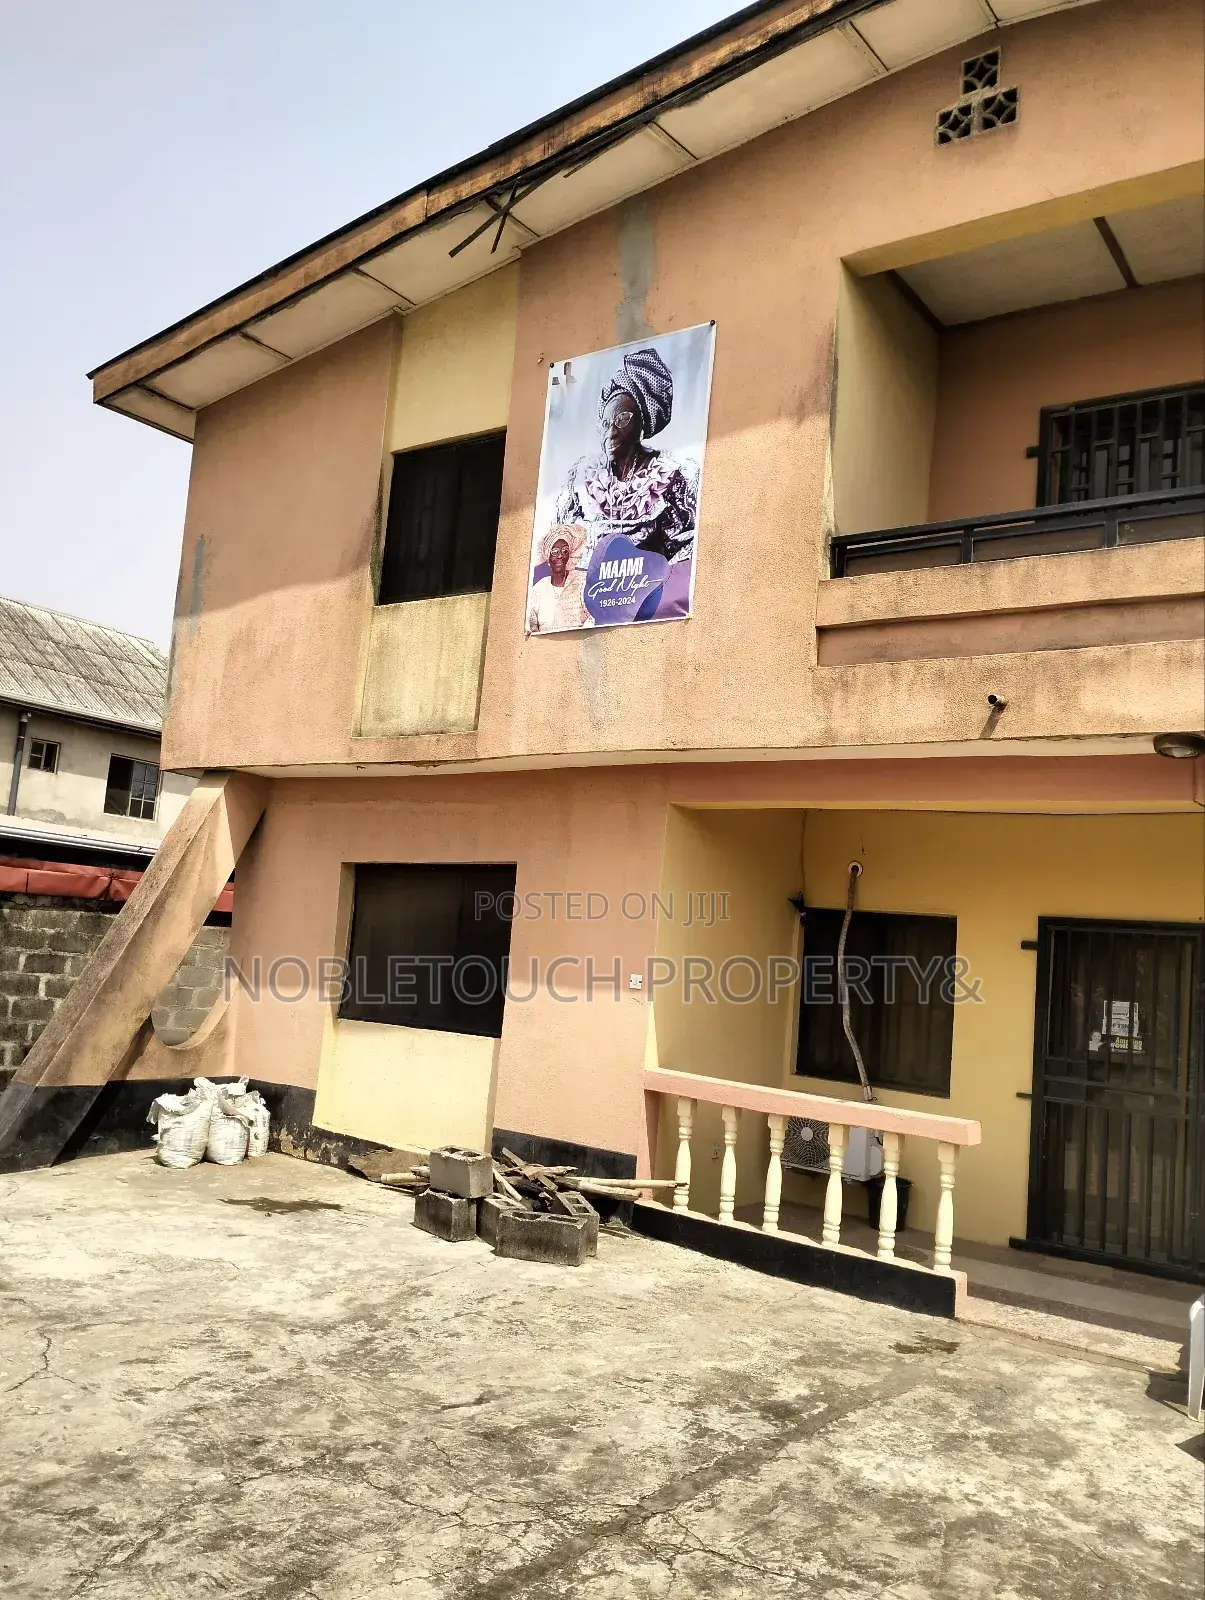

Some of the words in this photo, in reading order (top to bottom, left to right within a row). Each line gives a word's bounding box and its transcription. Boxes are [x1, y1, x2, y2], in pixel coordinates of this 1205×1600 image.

[599, 556, 645, 581] MAAMI
[587, 578, 618, 601] Good
[616, 574, 664, 597] Night
[599, 596, 636, 608] 1926-2024
